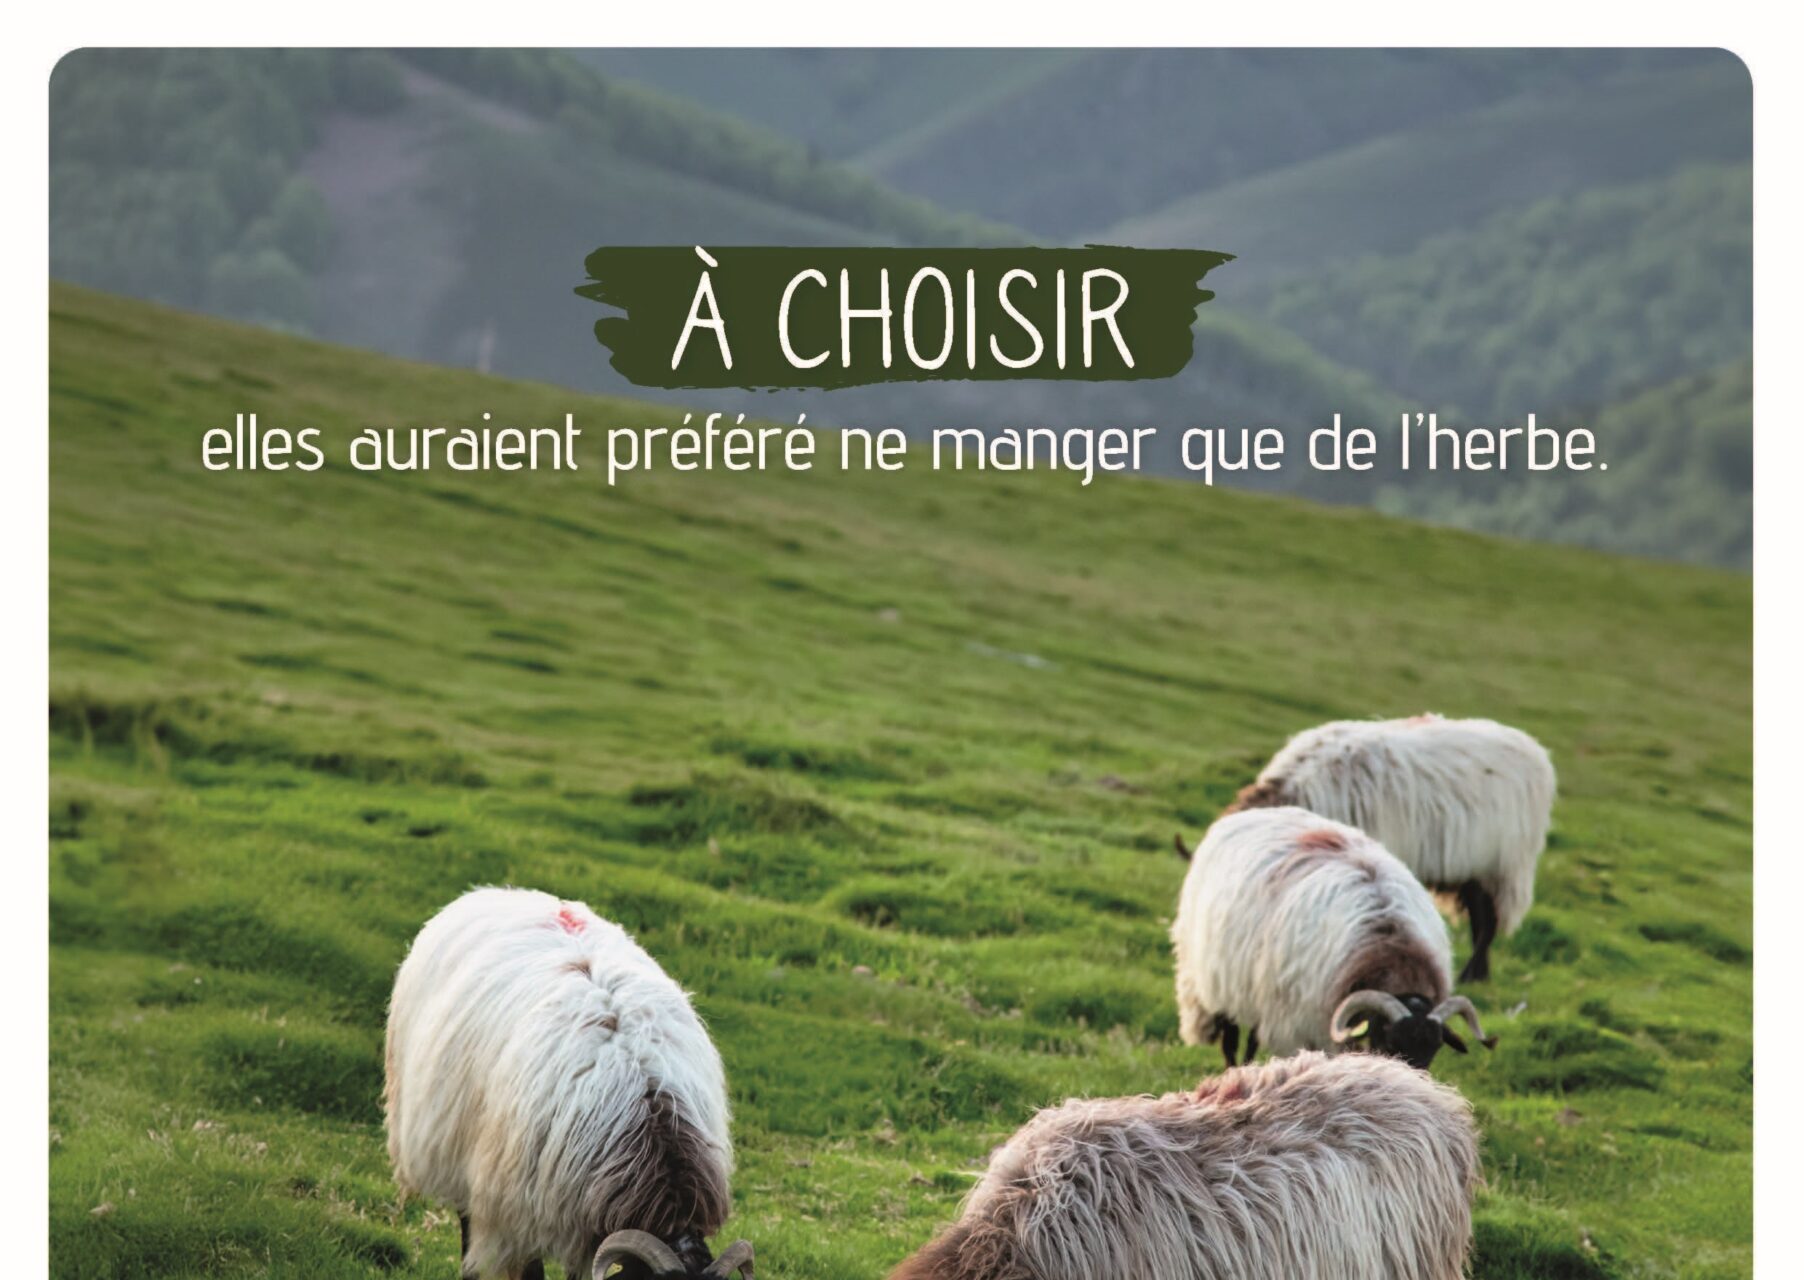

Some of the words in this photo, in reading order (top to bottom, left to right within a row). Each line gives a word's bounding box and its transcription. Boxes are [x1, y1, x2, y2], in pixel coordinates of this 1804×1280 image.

[672, 245, 732, 370] À
[779, 267, 1134, 369] CHOISIR
[203, 414, 324, 471] elles
[350, 413, 581, 470] auraient
[608, 413, 815, 485] préféré
[842, 428, 906, 470] ne
[933, 428, 1156, 486] manger
[1182, 428, 1284, 486] que
[1309, 413, 1376, 470] de
[1402, 413, 1607, 470] l'herbe.
